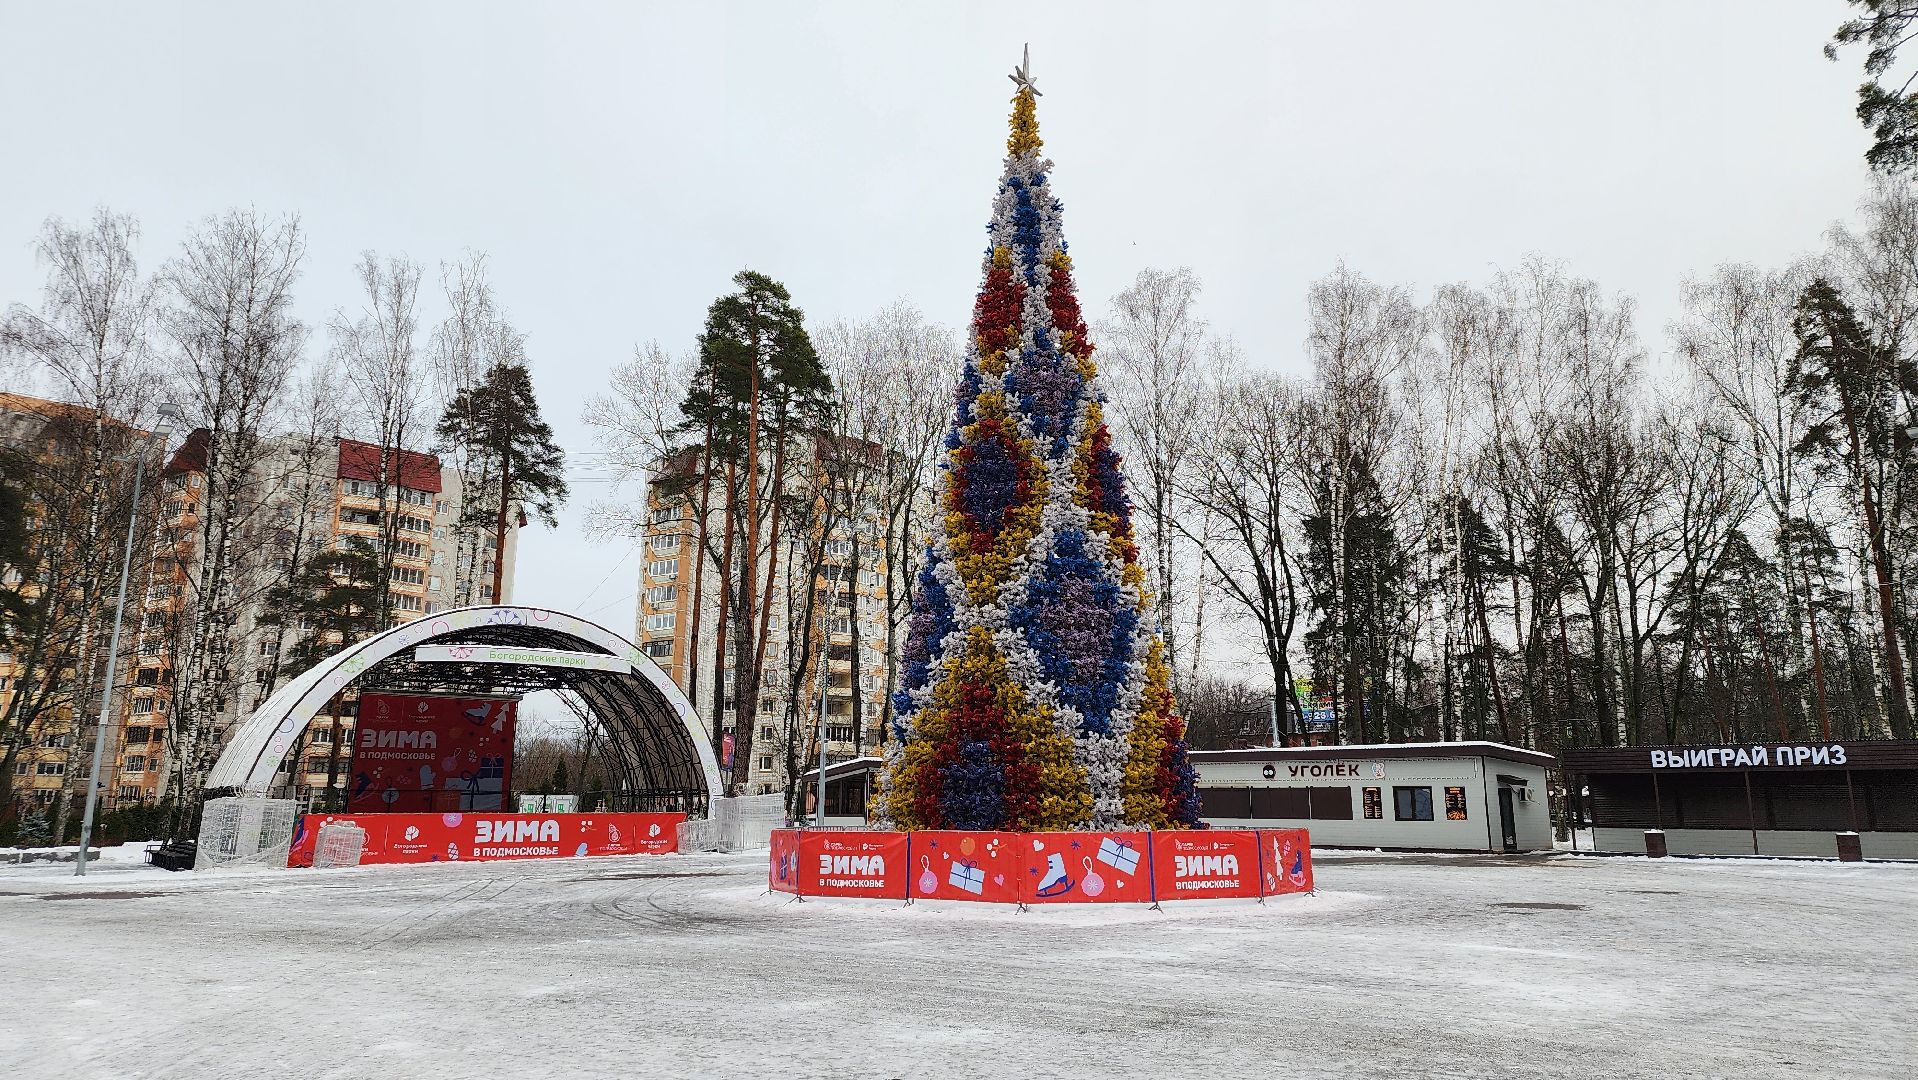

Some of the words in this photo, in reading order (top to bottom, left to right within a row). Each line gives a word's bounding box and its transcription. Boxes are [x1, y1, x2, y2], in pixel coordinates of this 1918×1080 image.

[489, 651, 556, 663] Богородские
[559, 657, 586, 666] парки
[361, 729, 437, 748] ЗИМА
[368, 752, 436, 761] ПОДМОСКОВЬЕ
[1650, 746, 1769, 768] ВЫИГРАЙ
[1776, 745, 1847, 766] ПРИЗ
[1288, 761, 1360, 777] УГОЛЁК
[474, 820, 559, 843] ЗИМА
[473, 848, 480, 857] В
[482, 846, 559, 857] ПОДМОСКОВЬЕ
[820, 855, 884, 875] ЗИМА
[1174, 854, 1239, 877] ЗИМА
[827, 879, 884, 888] ПОДМОСКОВЬЕ
[1176, 882, 1182, 890] В
[1182, 880, 1239, 890] ПОДМОСКОВЬЕ
